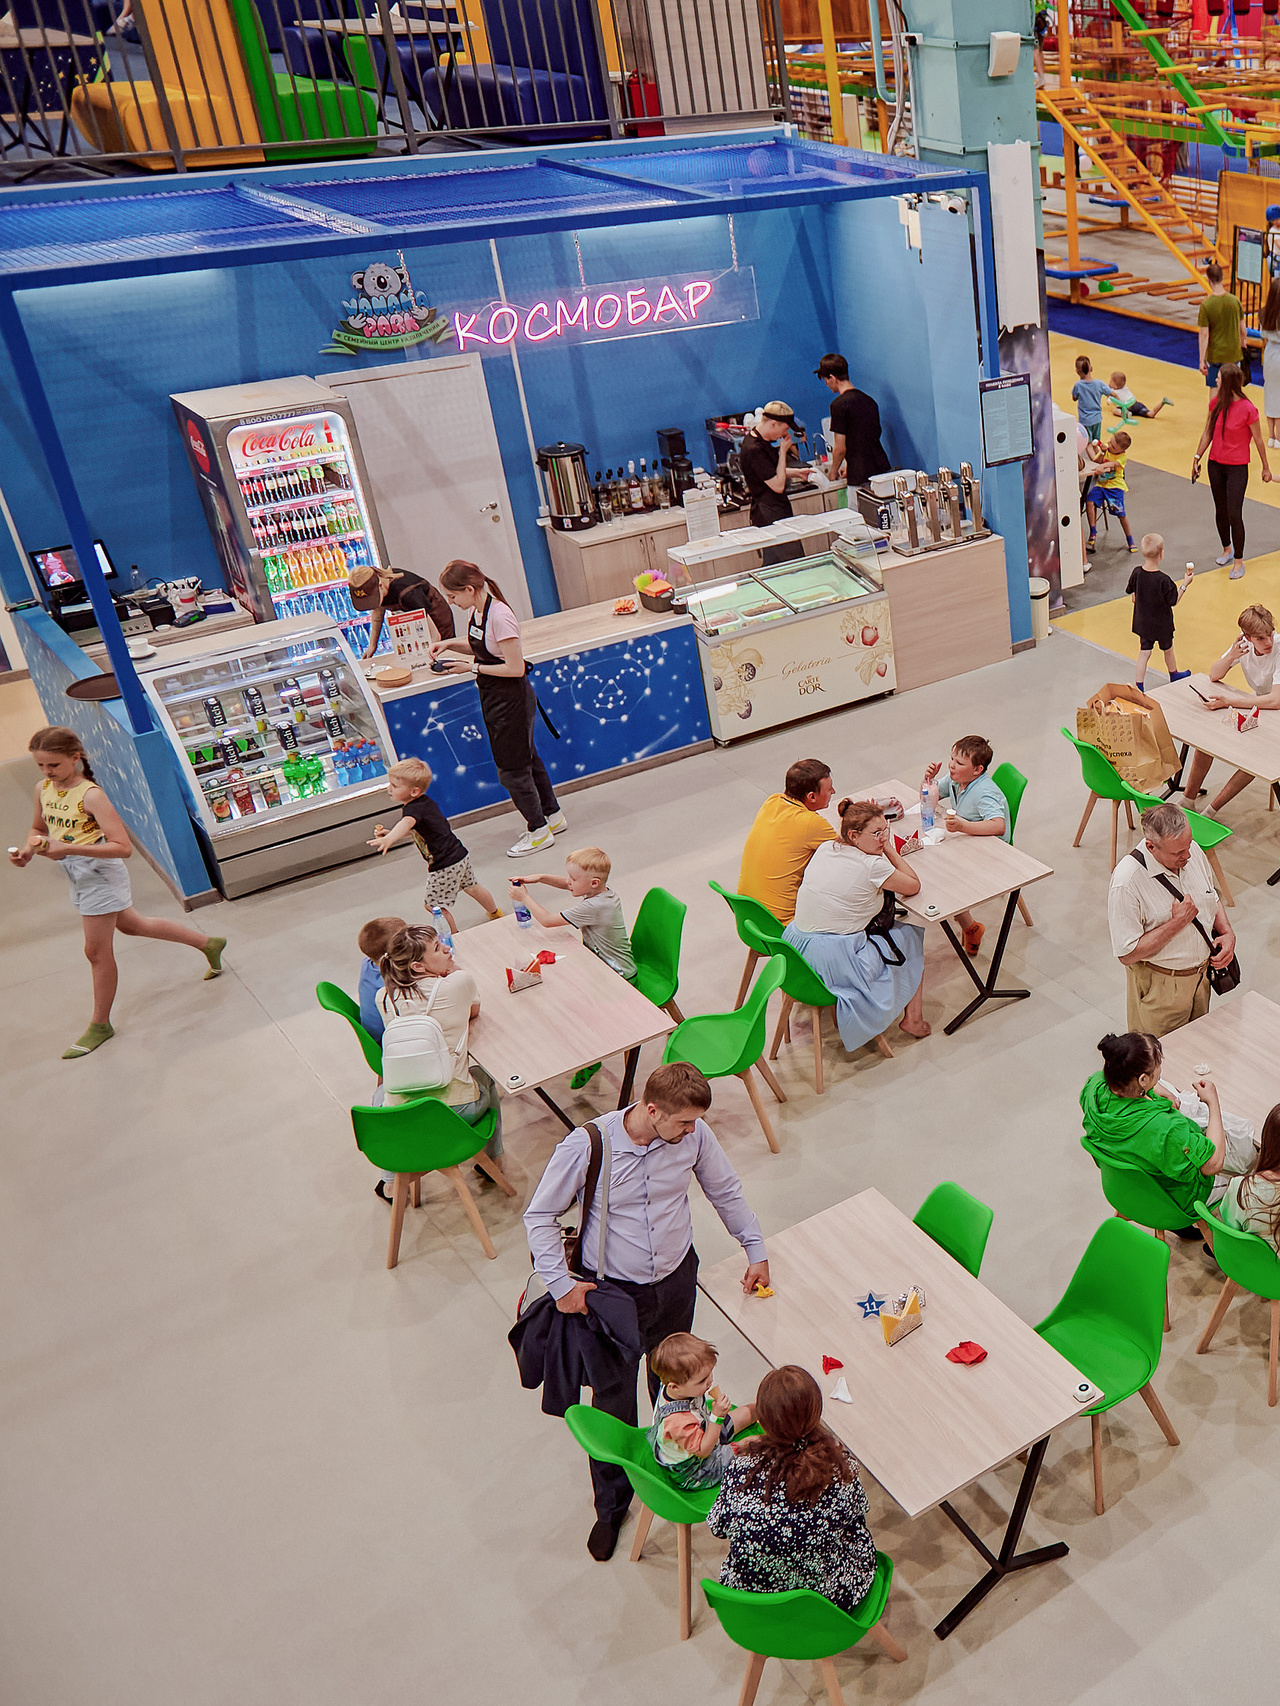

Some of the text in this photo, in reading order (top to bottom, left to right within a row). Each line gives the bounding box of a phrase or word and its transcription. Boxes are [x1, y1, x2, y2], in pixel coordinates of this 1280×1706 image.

[363, 312, 420, 338] PARK
[454, 280, 712, 350] КОСМОБАР
[242, 422, 316, 458] Coca-Cola
[881, 512, 889, 529] Rich
[781, 656, 832, 680] Gelateria
[327, 677, 339, 697] Rich
[797, 676, 819, 688] CARTE
[252, 695, 264, 715] Rich
[211, 705, 225, 726] Rich
[329, 717, 341, 736] Rich
[283, 730, 296, 749] Rich
[225, 745, 239, 765] Rich
[864, 1301, 879, 1313] 11
